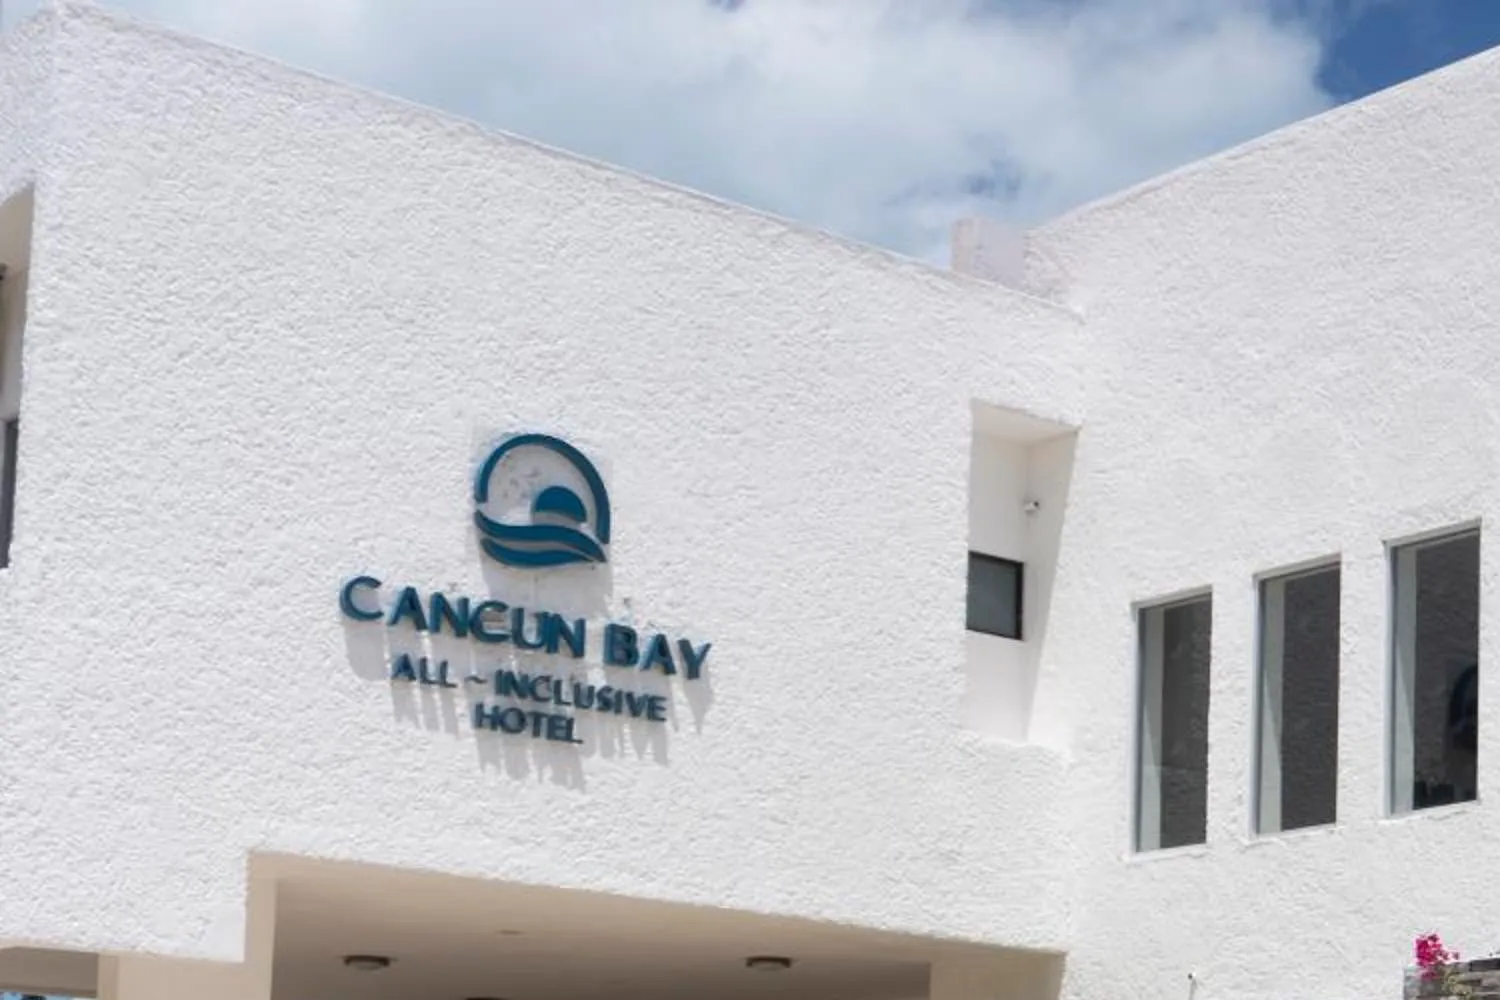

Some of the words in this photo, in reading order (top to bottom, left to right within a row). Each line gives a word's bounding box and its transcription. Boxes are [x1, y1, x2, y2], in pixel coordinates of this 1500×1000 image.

[339, 576, 586, 659] CANCUN
[603, 622, 711, 680] BAY
[391, 653, 458, 689] ALL
[494, 669, 667, 722] INCLUSIVE
[474, 703, 584, 744] HOTEL
